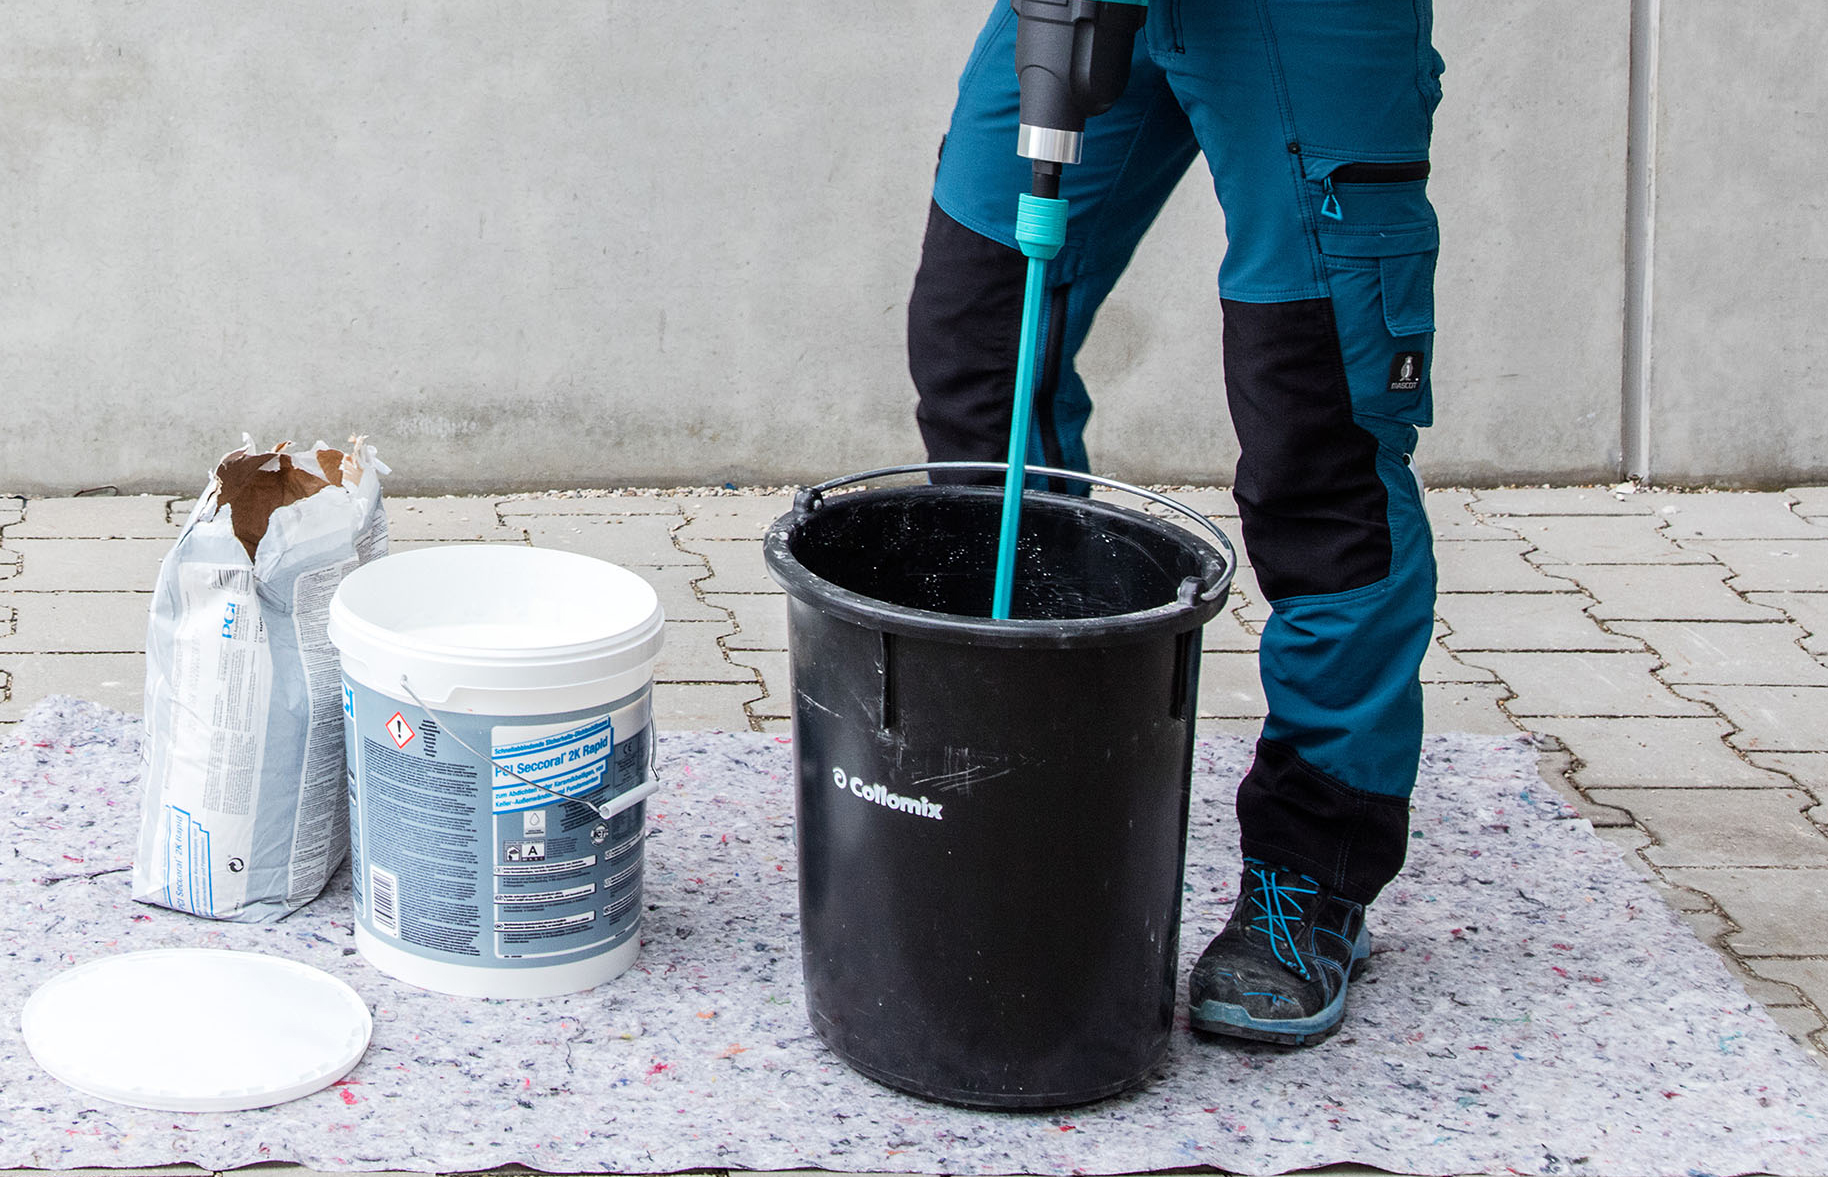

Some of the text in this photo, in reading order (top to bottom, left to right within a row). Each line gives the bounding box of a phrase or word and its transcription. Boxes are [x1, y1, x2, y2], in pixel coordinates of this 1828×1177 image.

[1391, 382, 1417, 390] MASCOT
[222, 602, 236, 639] PCI
[495, 764, 513, 778] PCI
[568, 748, 581, 762] 2K
[583, 735, 608, 757] Rapid
[849, 776, 943, 820] Collomix
[175, 814, 184, 842] Rapid
[175, 843, 183, 856] 2K
[528, 845, 538, 856] A
